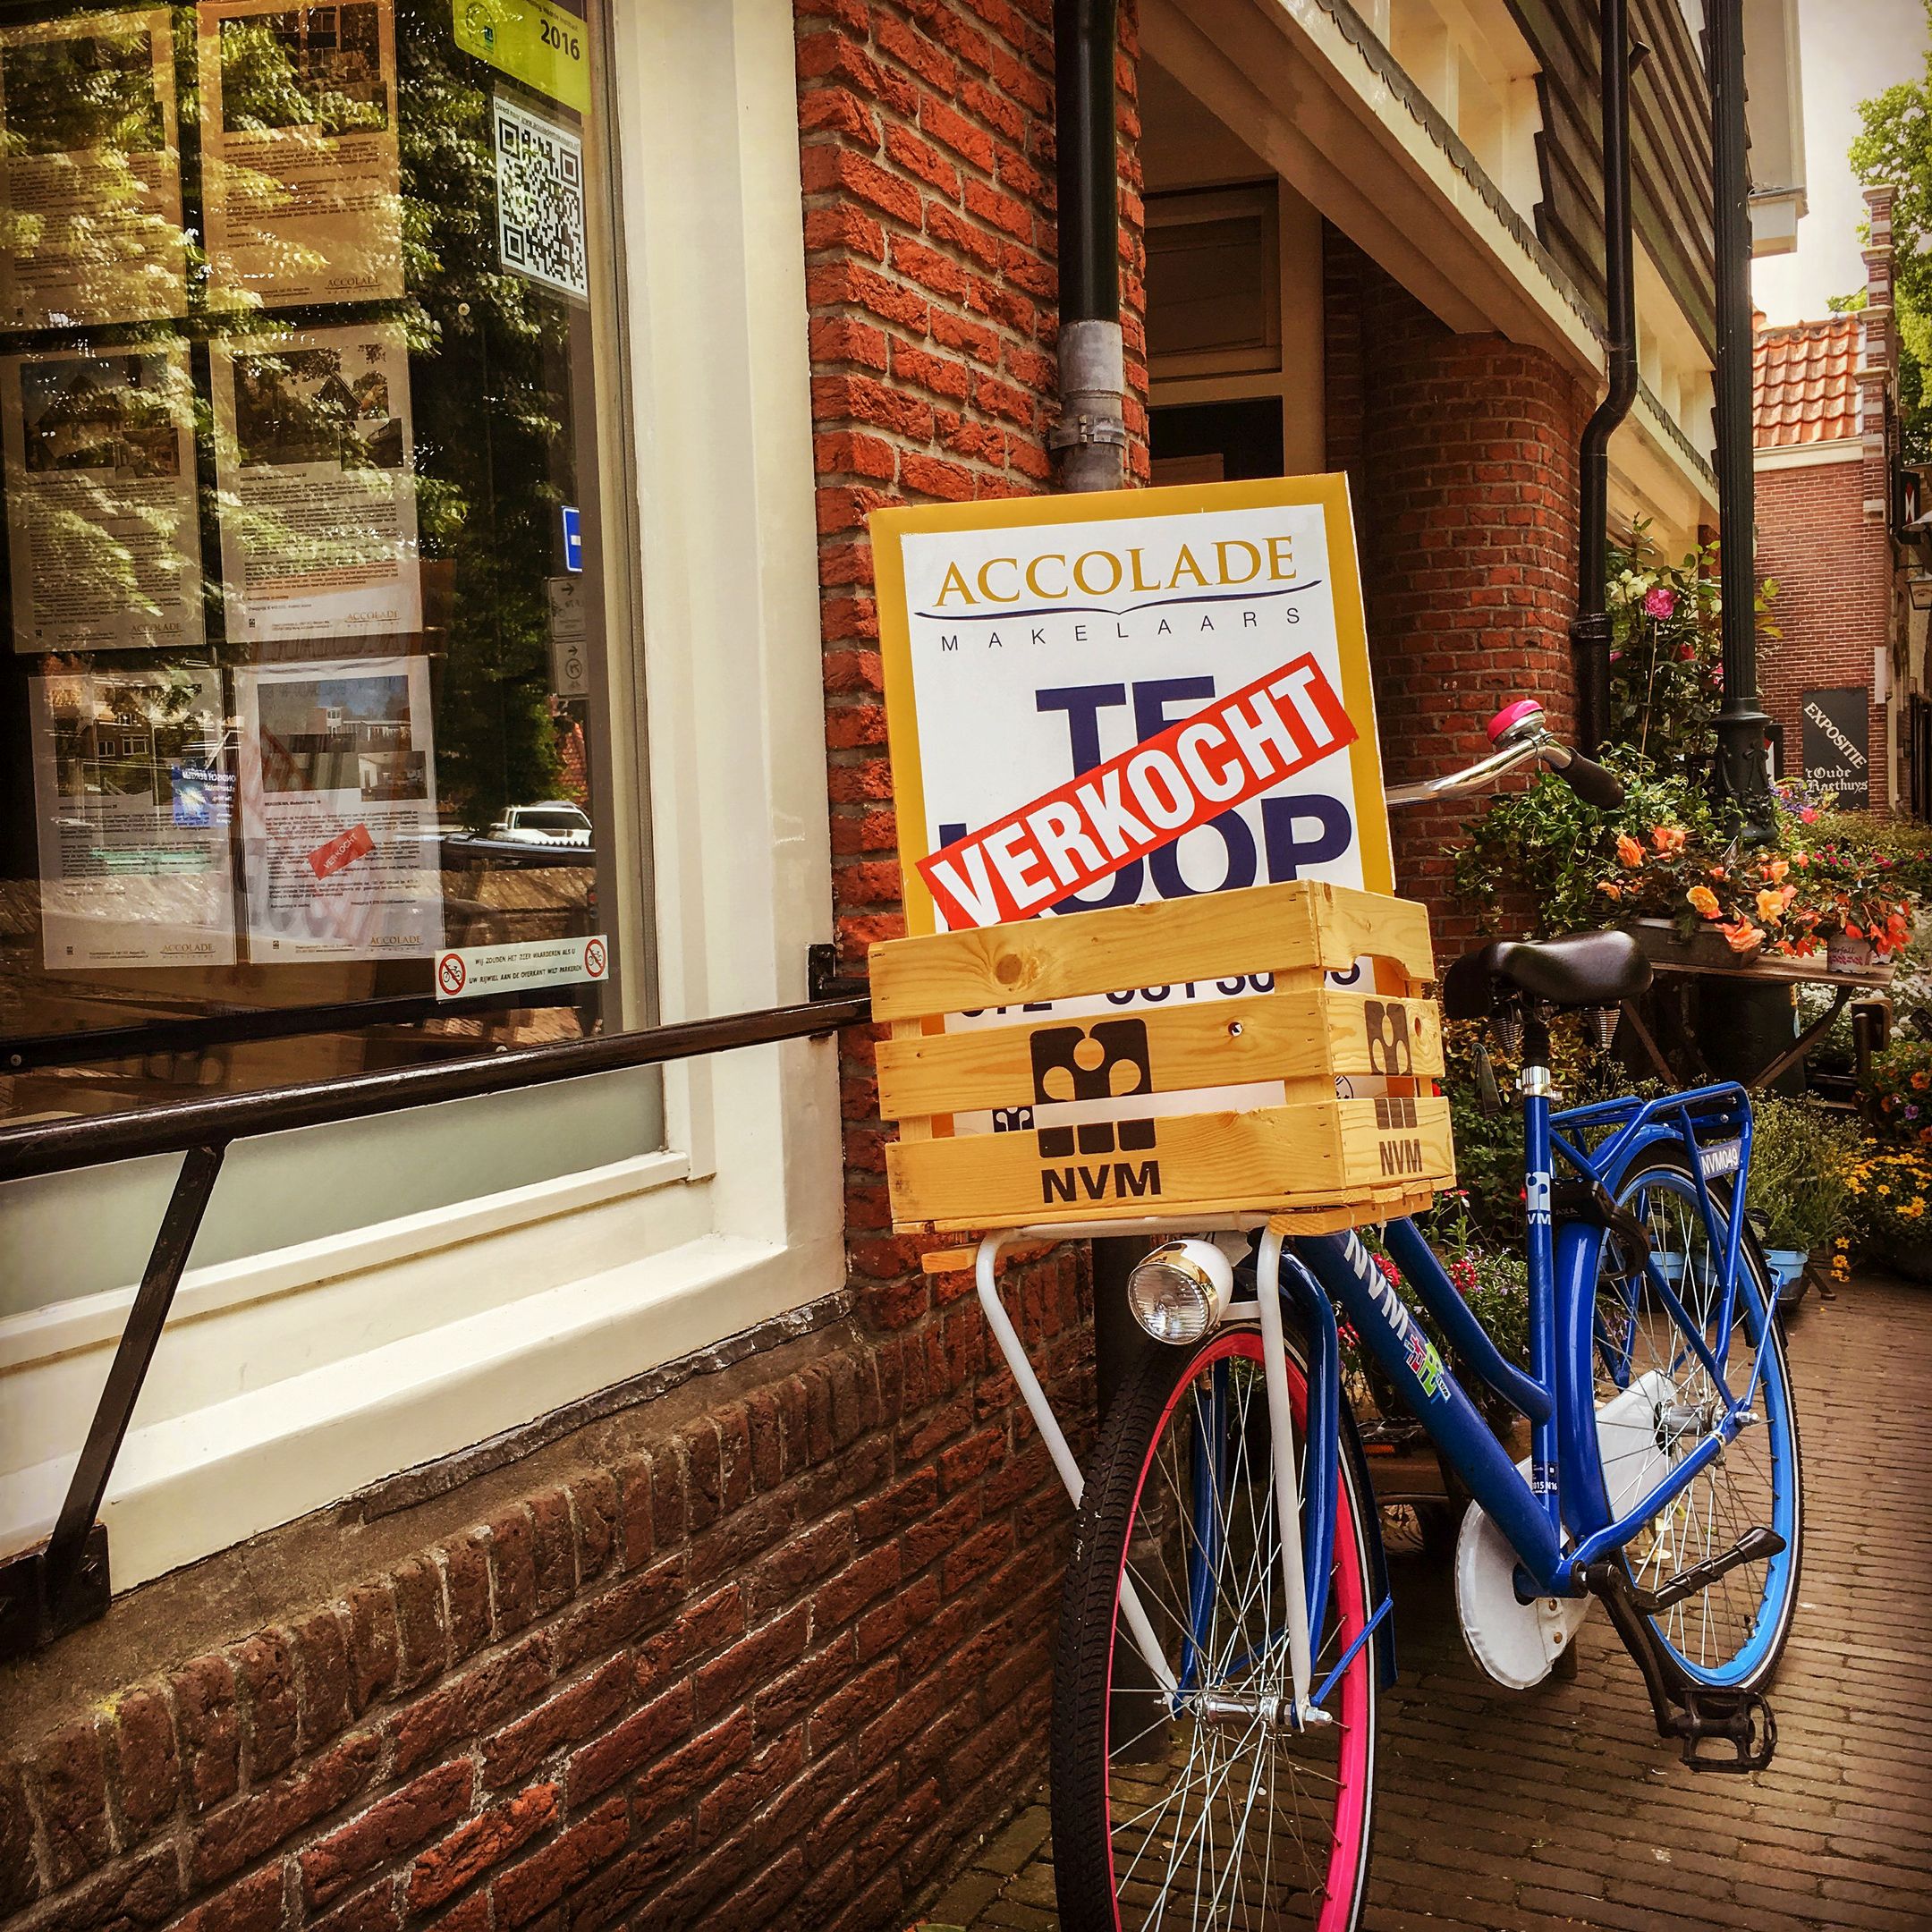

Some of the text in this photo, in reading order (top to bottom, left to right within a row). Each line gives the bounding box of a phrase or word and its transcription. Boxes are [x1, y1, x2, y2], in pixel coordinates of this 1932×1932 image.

[539, 19, 580, 61] 2016
[934, 535, 1298, 608] ACCOLADE
[942, 606, 1301, 652] MAKELAARS
[1803, 701, 1868, 769] EXPOSITIE
[929, 664, 1338, 928] VERKOCHT
[323, 833, 358, 869] VERKOCHT
[486, 956, 506, 964] ZOUDEN
[520, 969, 546, 979] OVERKANT
[559, 965, 582, 973] PARKEREN
[1378, 1139, 1424, 1176] NVM
[1700, 1148, 1740, 1175] NVM049
[1041, 1160, 1162, 1204] NVM
[1343, 1228, 1410, 1341] NVM
